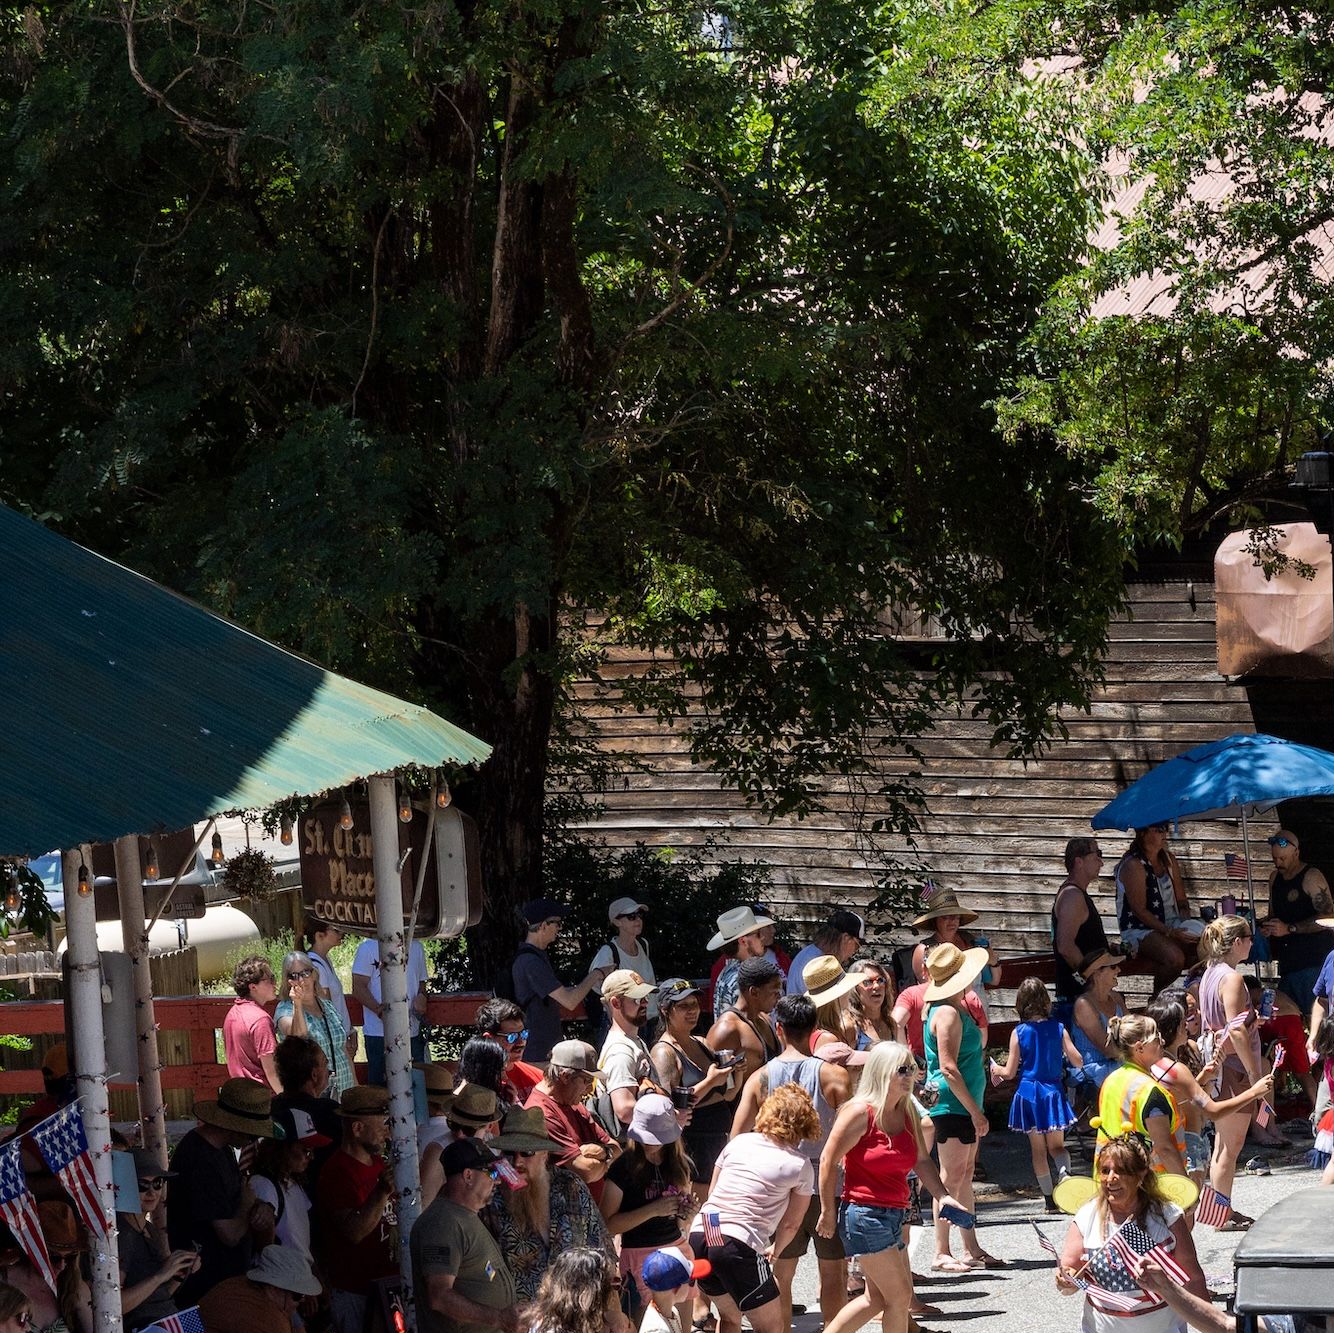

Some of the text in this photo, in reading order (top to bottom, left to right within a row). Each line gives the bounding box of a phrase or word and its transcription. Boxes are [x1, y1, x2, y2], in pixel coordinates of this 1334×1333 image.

[304, 817, 374, 858] St. Char
[314, 898, 378, 924] COCKTAI
